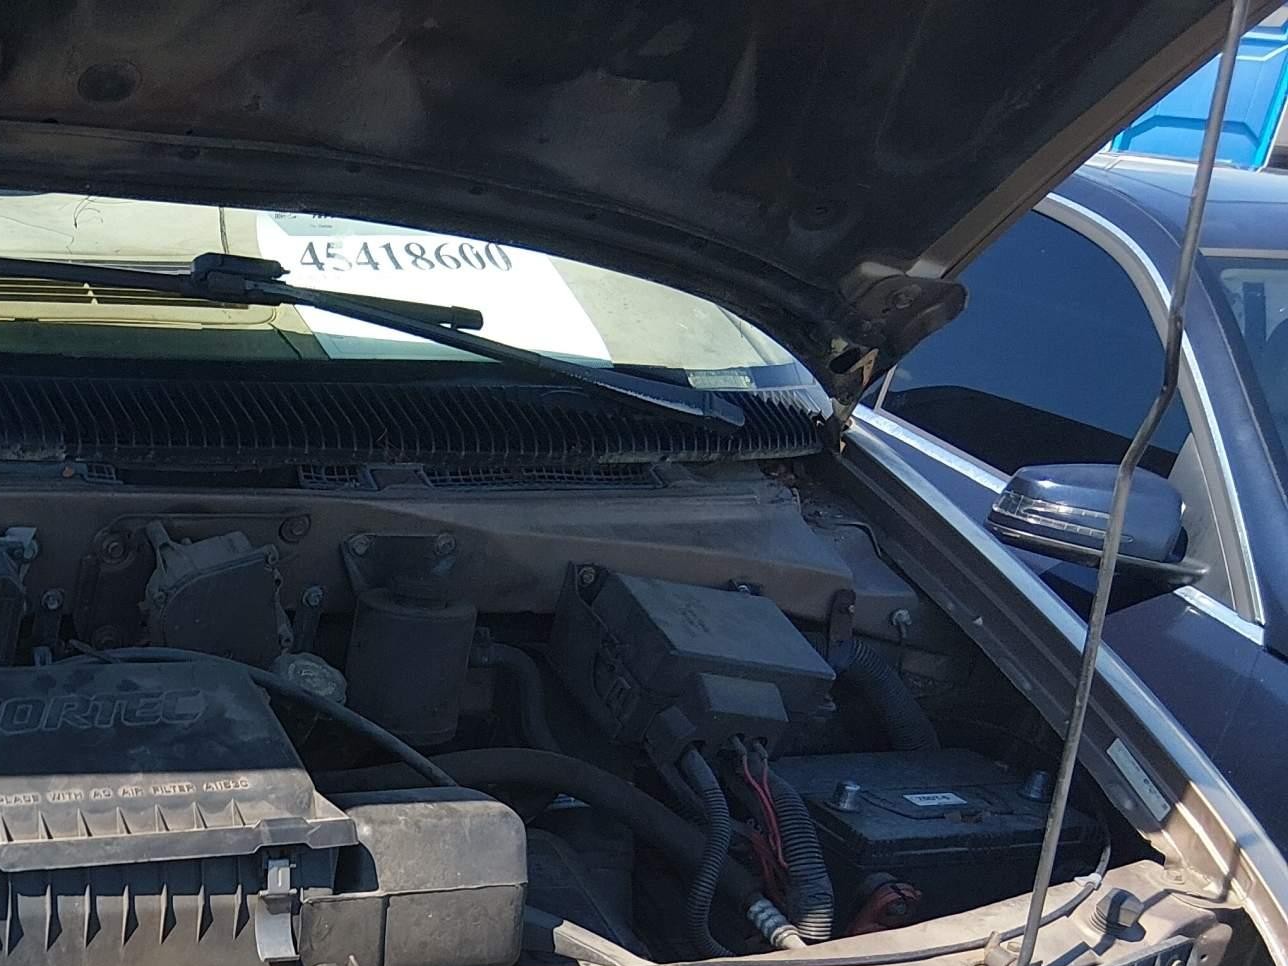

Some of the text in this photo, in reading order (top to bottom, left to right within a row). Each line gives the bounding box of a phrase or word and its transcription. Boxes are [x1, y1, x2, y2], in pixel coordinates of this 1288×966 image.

[299, 241, 513, 271] 45418600
[47, 788, 83, 803] WITH
[118, 784, 143, 797] AIR
[150, 782, 195, 796] FILTER
